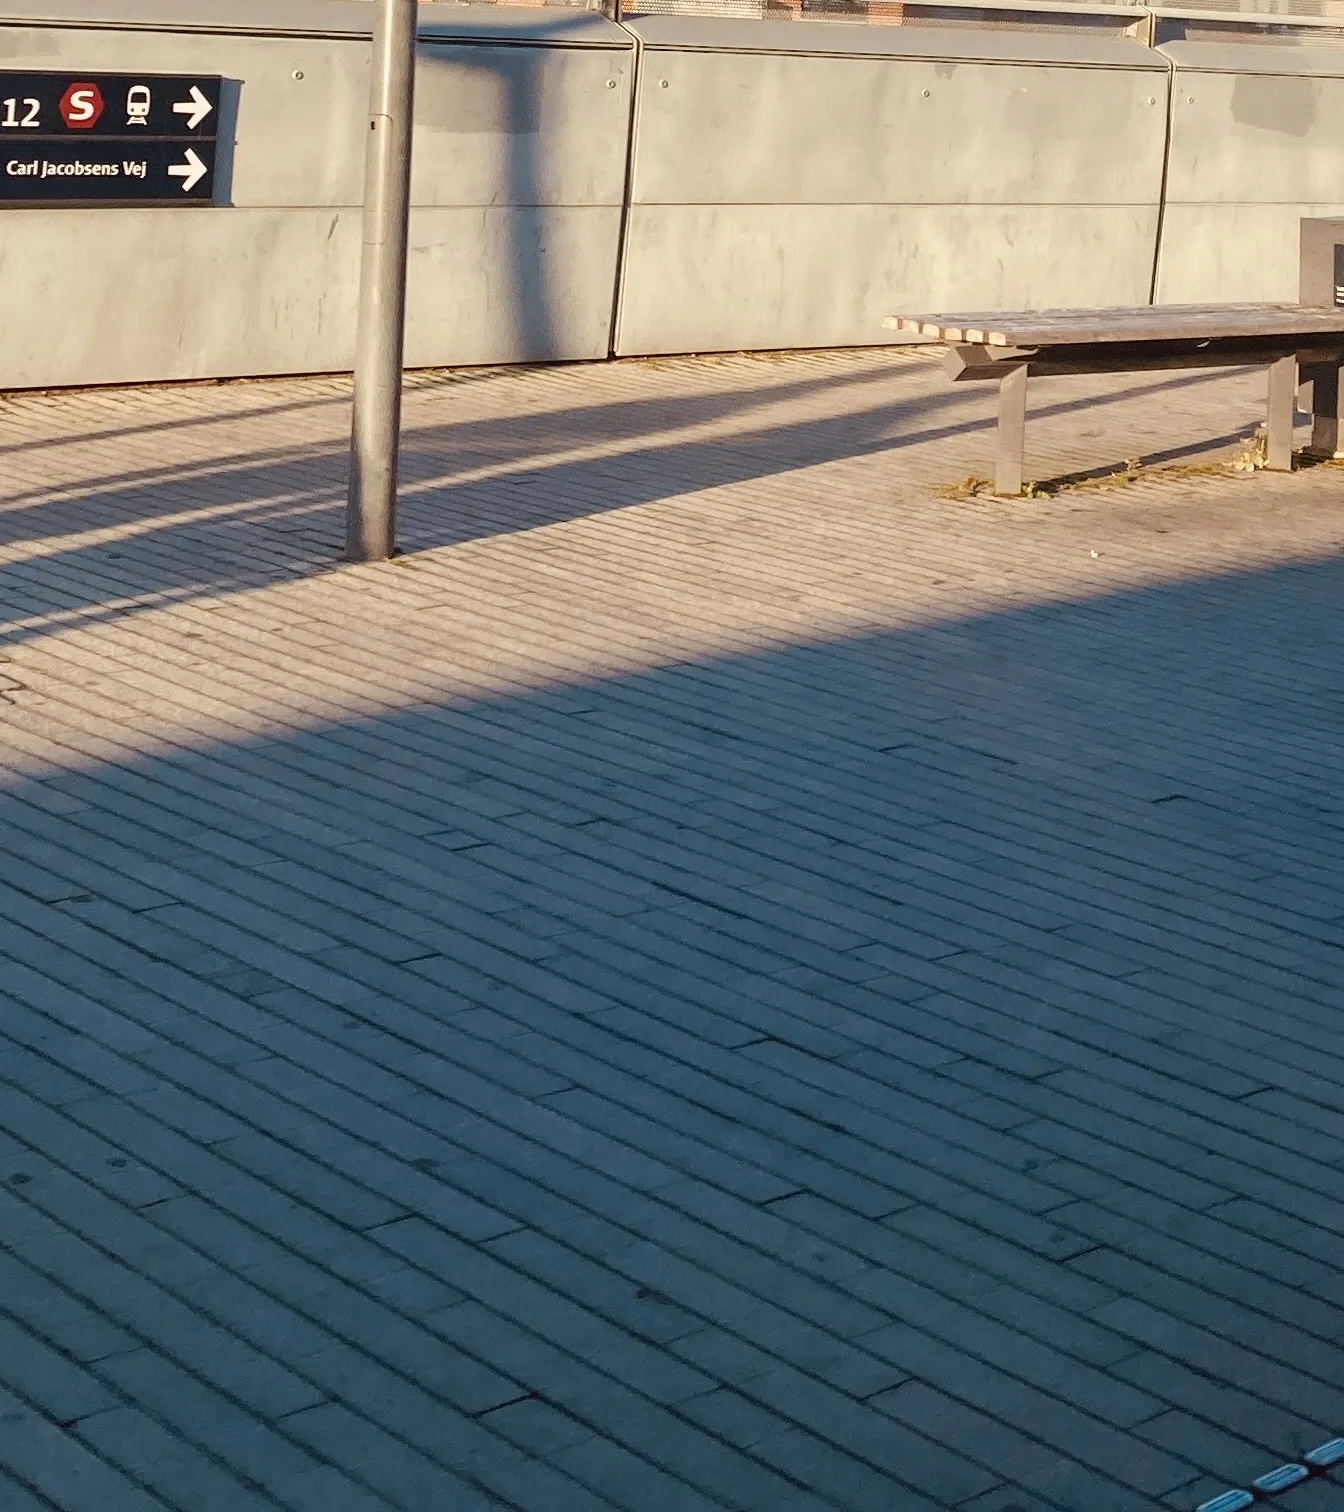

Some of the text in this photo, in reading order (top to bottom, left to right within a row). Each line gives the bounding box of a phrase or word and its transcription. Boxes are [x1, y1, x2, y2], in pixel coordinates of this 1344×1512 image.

[68, 90, 95, 121] S
[6, 160, 147, 179] Carl Jacobsens Vej
